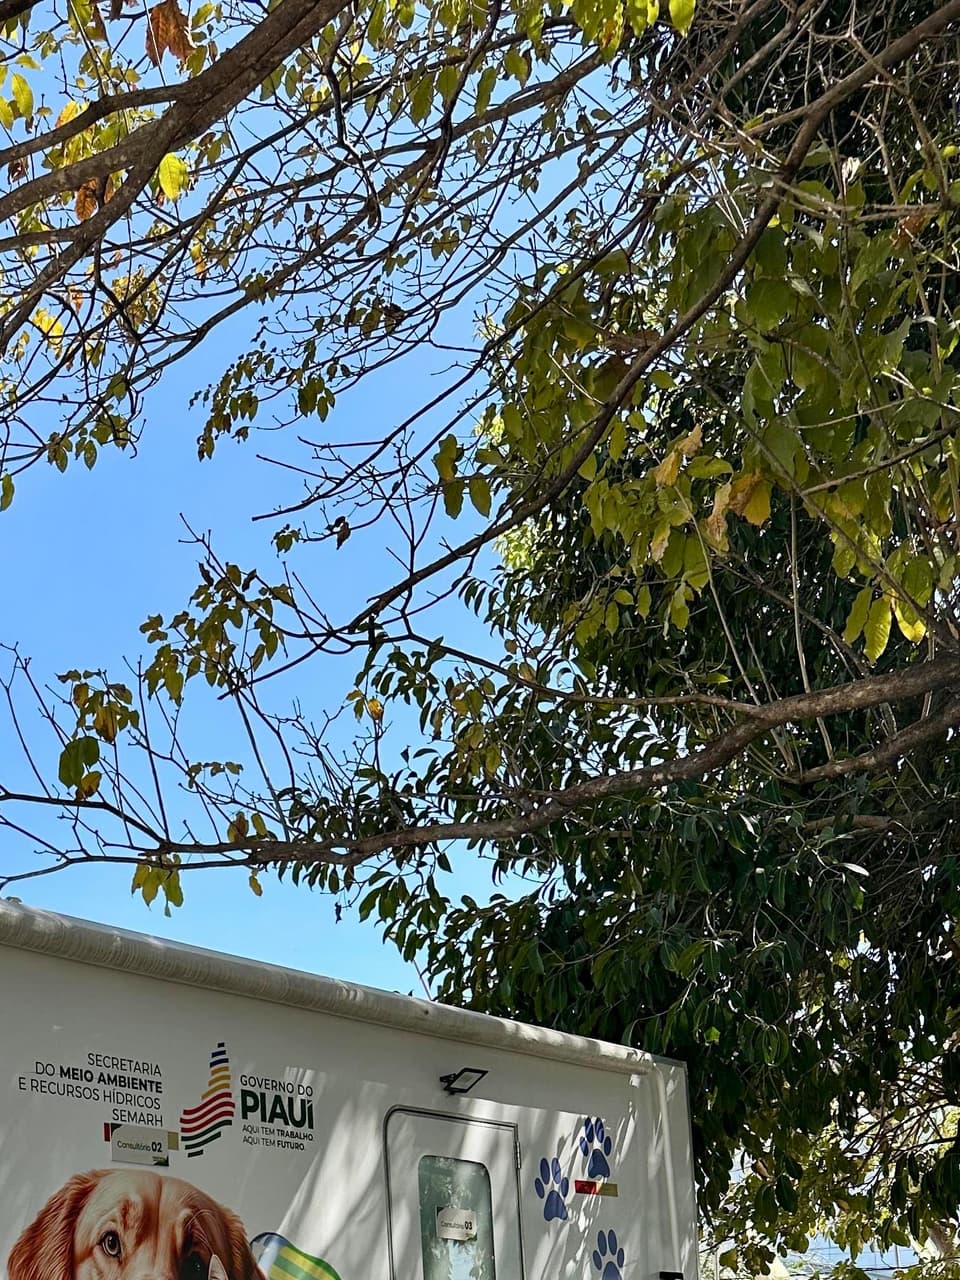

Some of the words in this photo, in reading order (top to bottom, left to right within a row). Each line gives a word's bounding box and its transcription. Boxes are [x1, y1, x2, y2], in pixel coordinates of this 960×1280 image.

[87, 1053, 162, 1077] SECRETARIA
[35, 1061, 56, 1076] DO
[59, 1065, 94, 1083] MEIO
[97, 1072, 163, 1094] AMBIENTE
[240, 1074, 294, 1094] GOVERNO
[297, 1084, 314, 1097] DO
[18, 1077, 27, 1091] E
[30, 1079, 100, 1102] RECURSOS
[103, 1087, 161, 1110] HÍDRICOS
[112, 1109, 163, 1127] SEMARH
[241, 1089, 314, 1129] PIAUÍ
[242, 1124, 260, 1135] AQUI
[261, 1127, 275, 1136] TEM
[151, 1141, 163, 1153] 02
[242, 1136, 260, 1146] AQUI
[261, 1138, 276, 1147] TEM
[464, 1221, 473, 1230] 03
